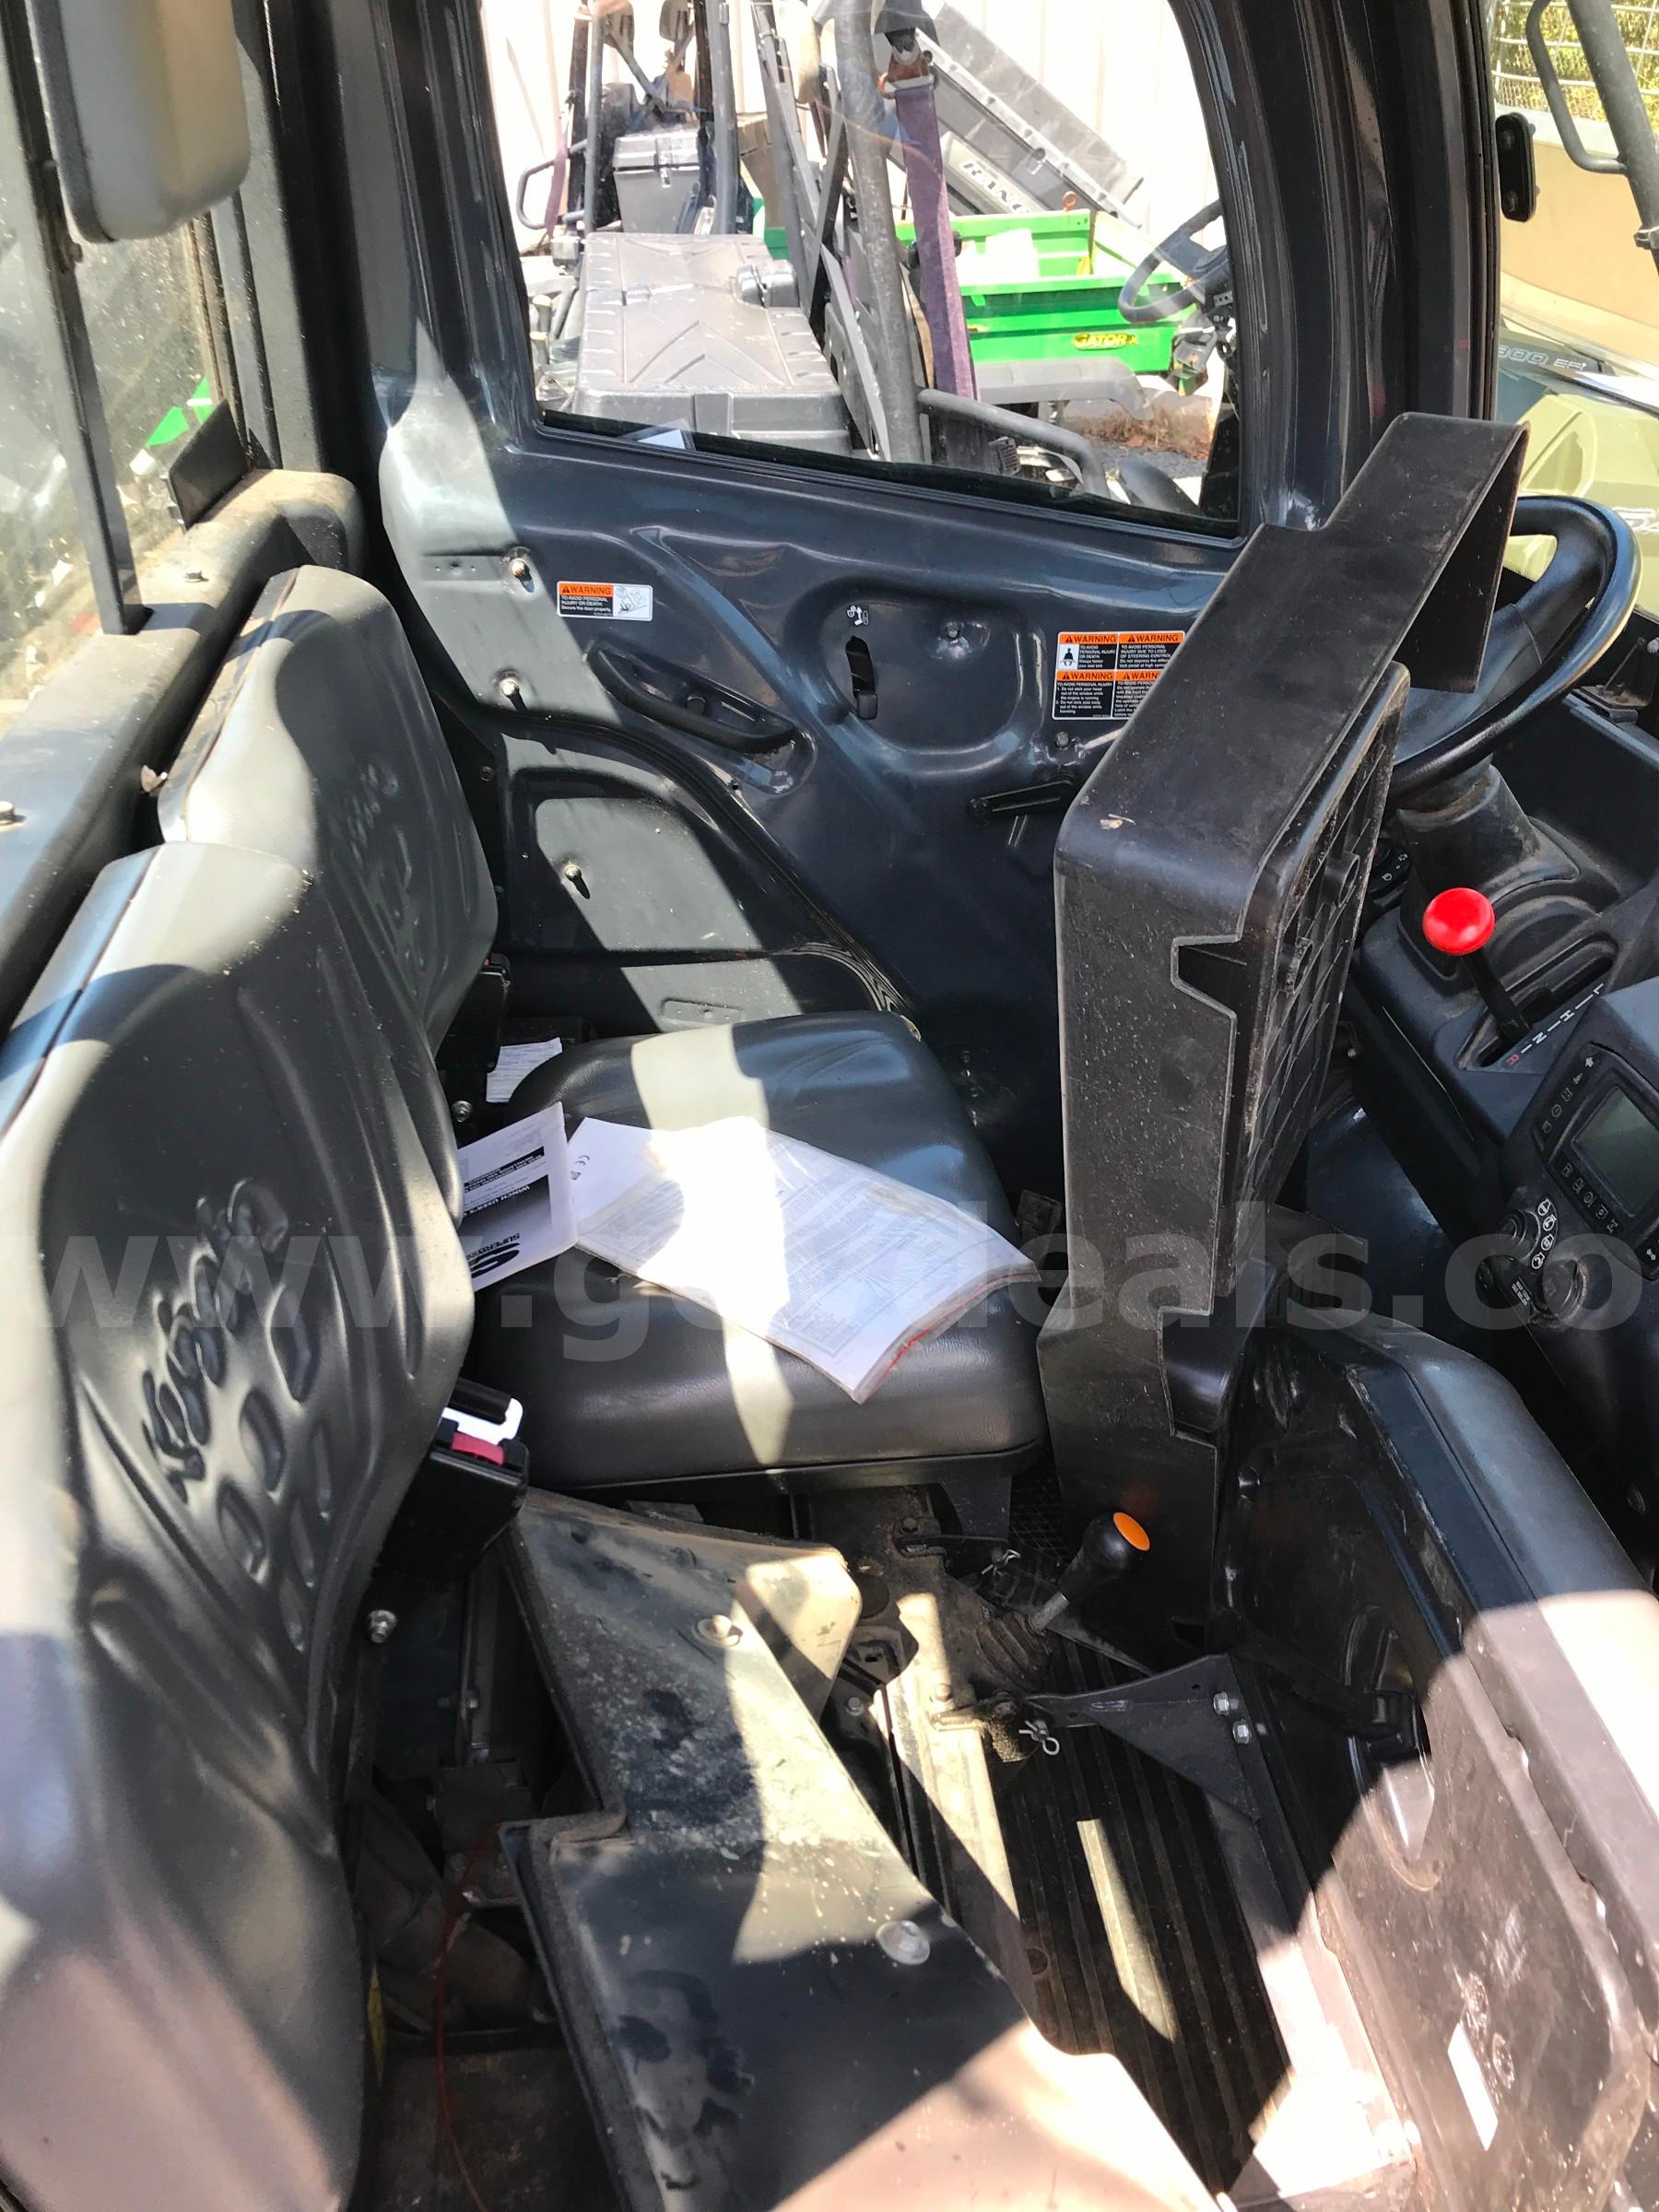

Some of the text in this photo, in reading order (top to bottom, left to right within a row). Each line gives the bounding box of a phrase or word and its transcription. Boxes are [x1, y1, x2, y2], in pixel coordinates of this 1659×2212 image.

[959, 161, 1031, 214] RANG
[1074, 333, 1127, 347] GATOR
[1553, 358, 1587, 371] EFI
[570, 585, 612, 595] WARNING
[1074, 635, 1117, 643] WARNING
[1136, 634, 1179, 642] WARNING
[1071, 672, 1113, 680] WARNING
[1505, 982, 1605, 1067] R N H L
[467, 1233, 521, 1263] SUPERWIN
